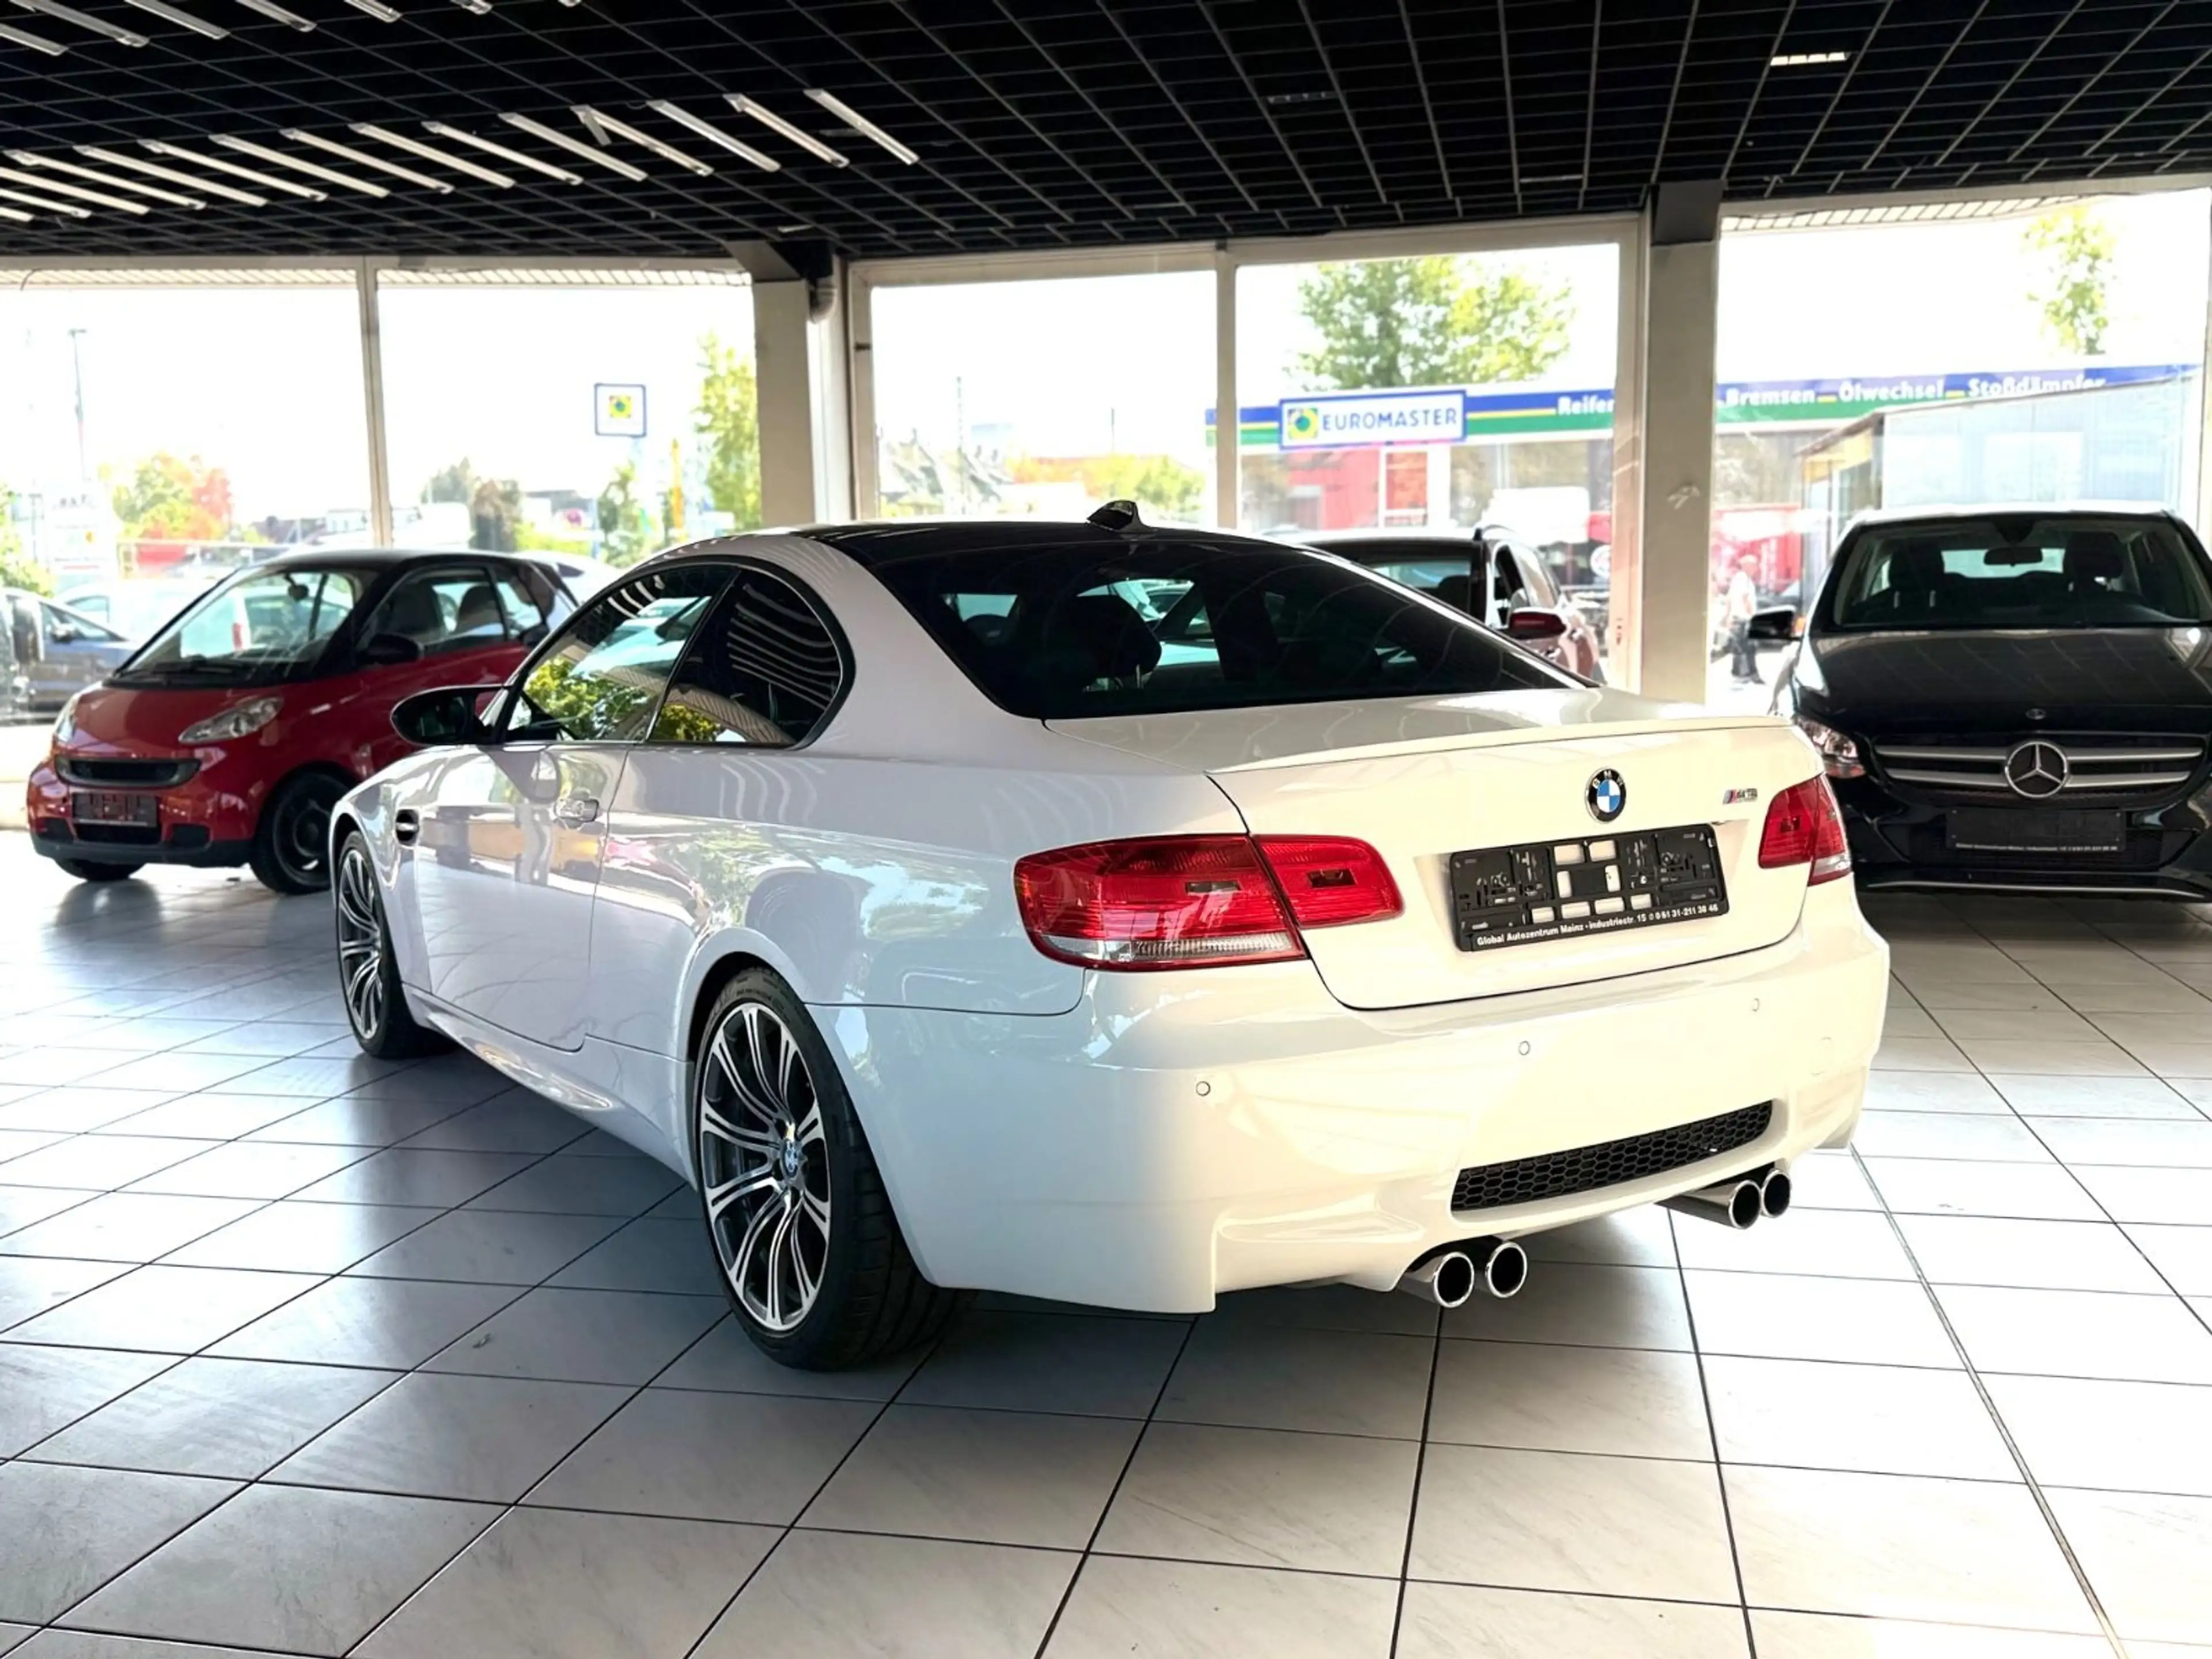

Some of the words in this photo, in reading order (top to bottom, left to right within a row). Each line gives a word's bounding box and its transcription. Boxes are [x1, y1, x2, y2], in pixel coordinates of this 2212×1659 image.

[1725, 386, 1816, 406] Bremsen
[1839, 379, 1944, 402] Ölwechsel
[1323, 407, 1457, 431] EUROMASTER
[1477, 933, 1505, 945] Global
[1506, 927, 1559, 941] Autozentrum
[1560, 923, 1584, 934] Mainz
